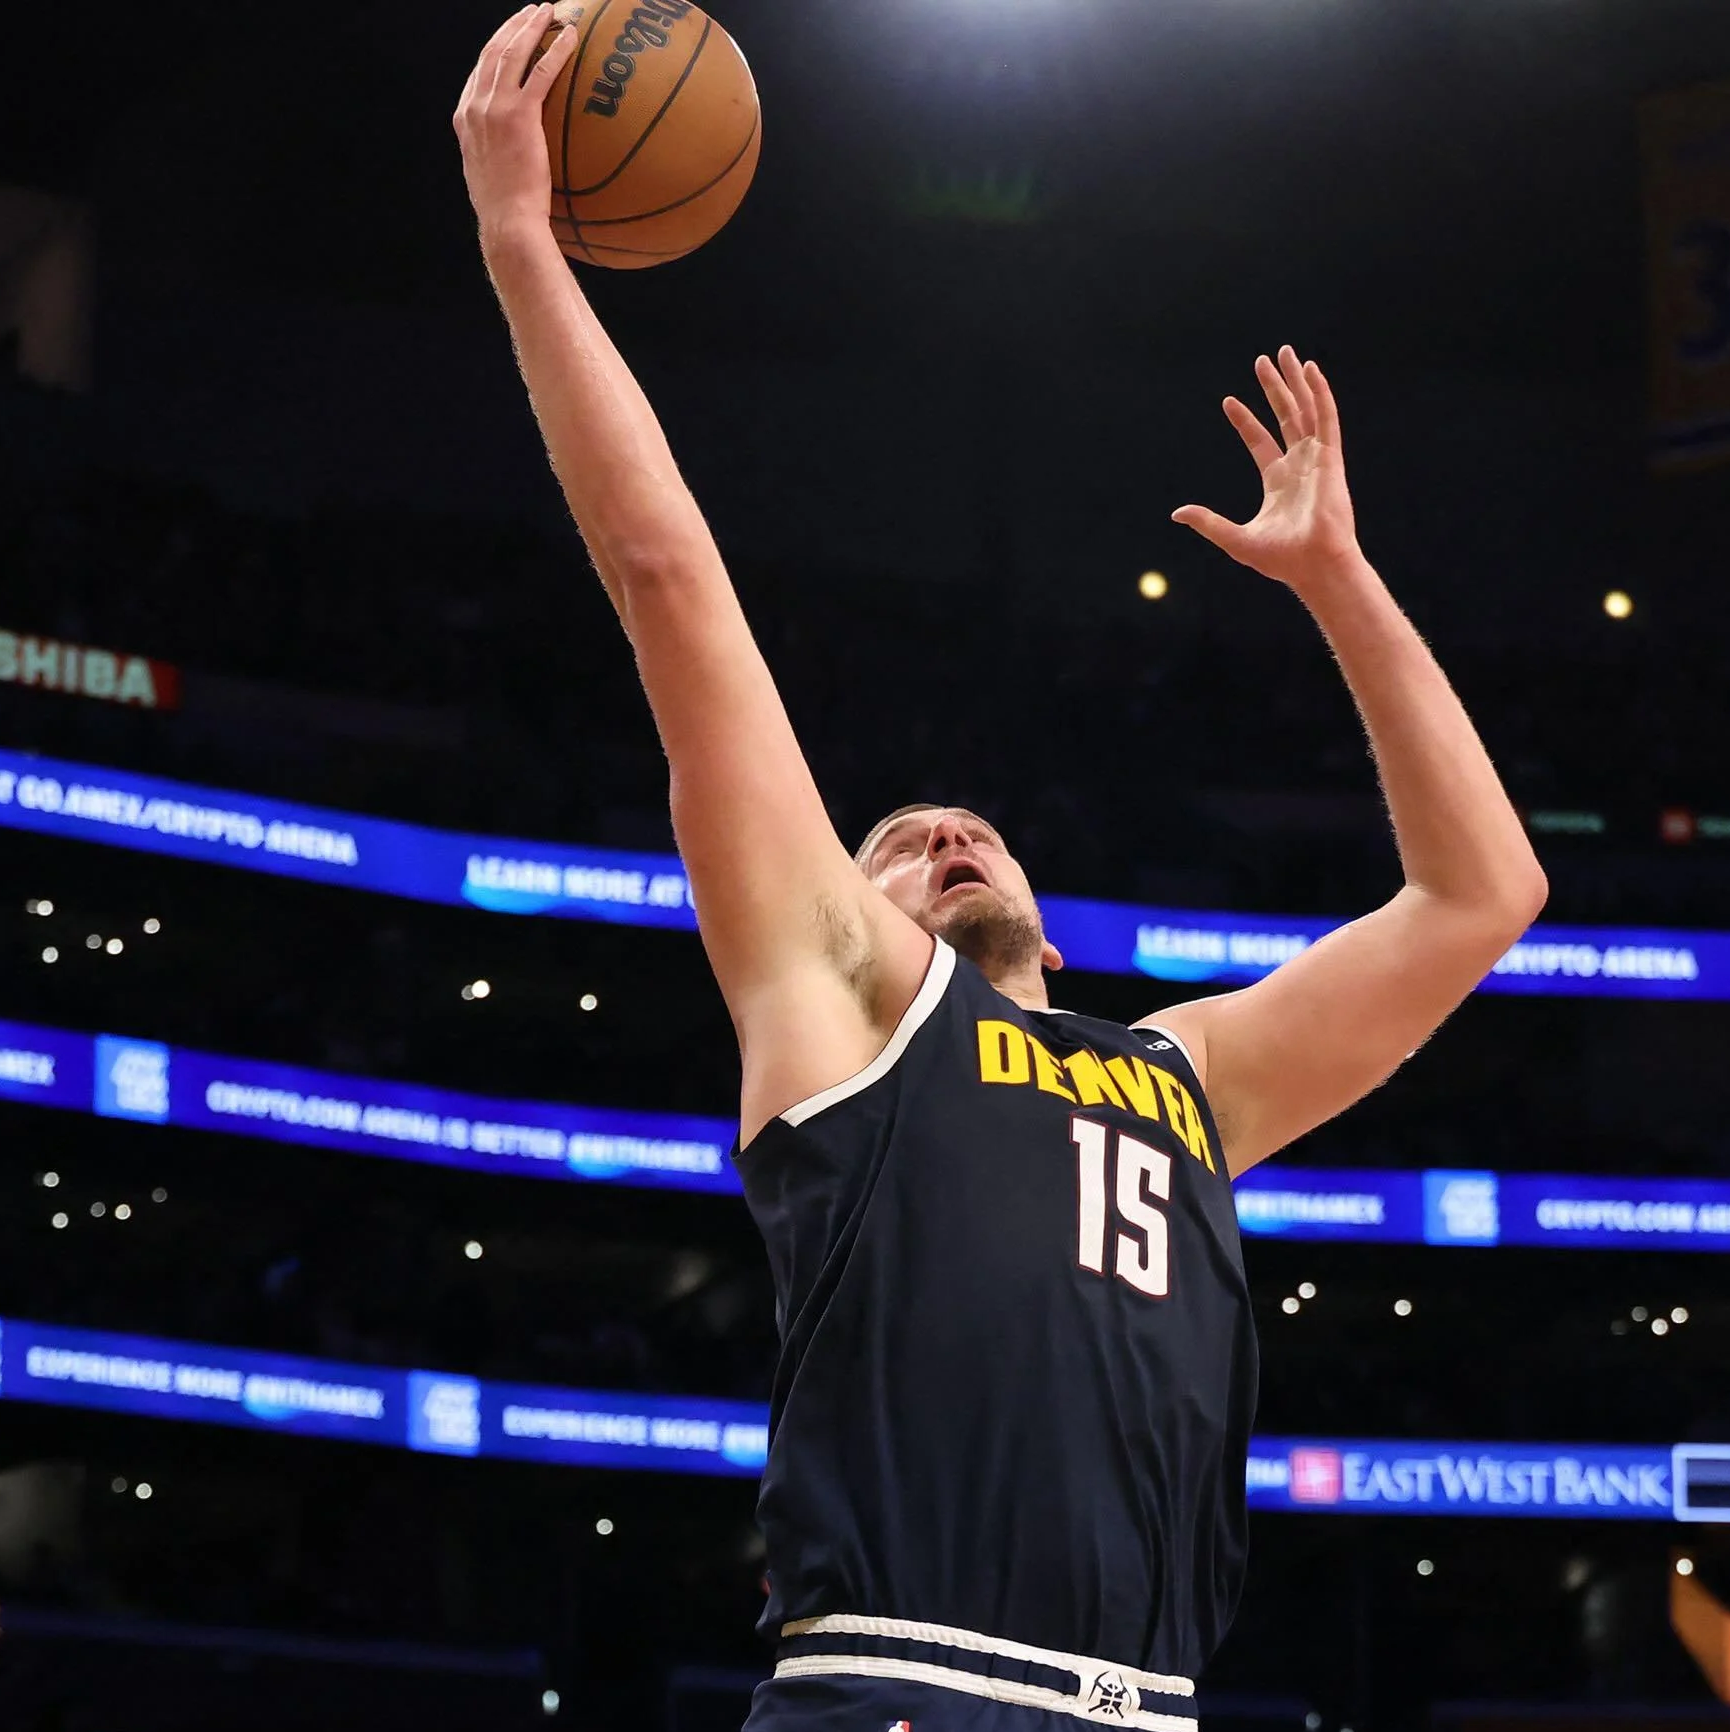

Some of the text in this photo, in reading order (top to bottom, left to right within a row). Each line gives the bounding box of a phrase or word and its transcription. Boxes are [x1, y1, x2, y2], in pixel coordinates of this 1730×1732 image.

[976, 1018, 1217, 1176] DENVER
[1069, 1109, 1173, 1300] 15
[1554, 1457, 1671, 1509] BANK
